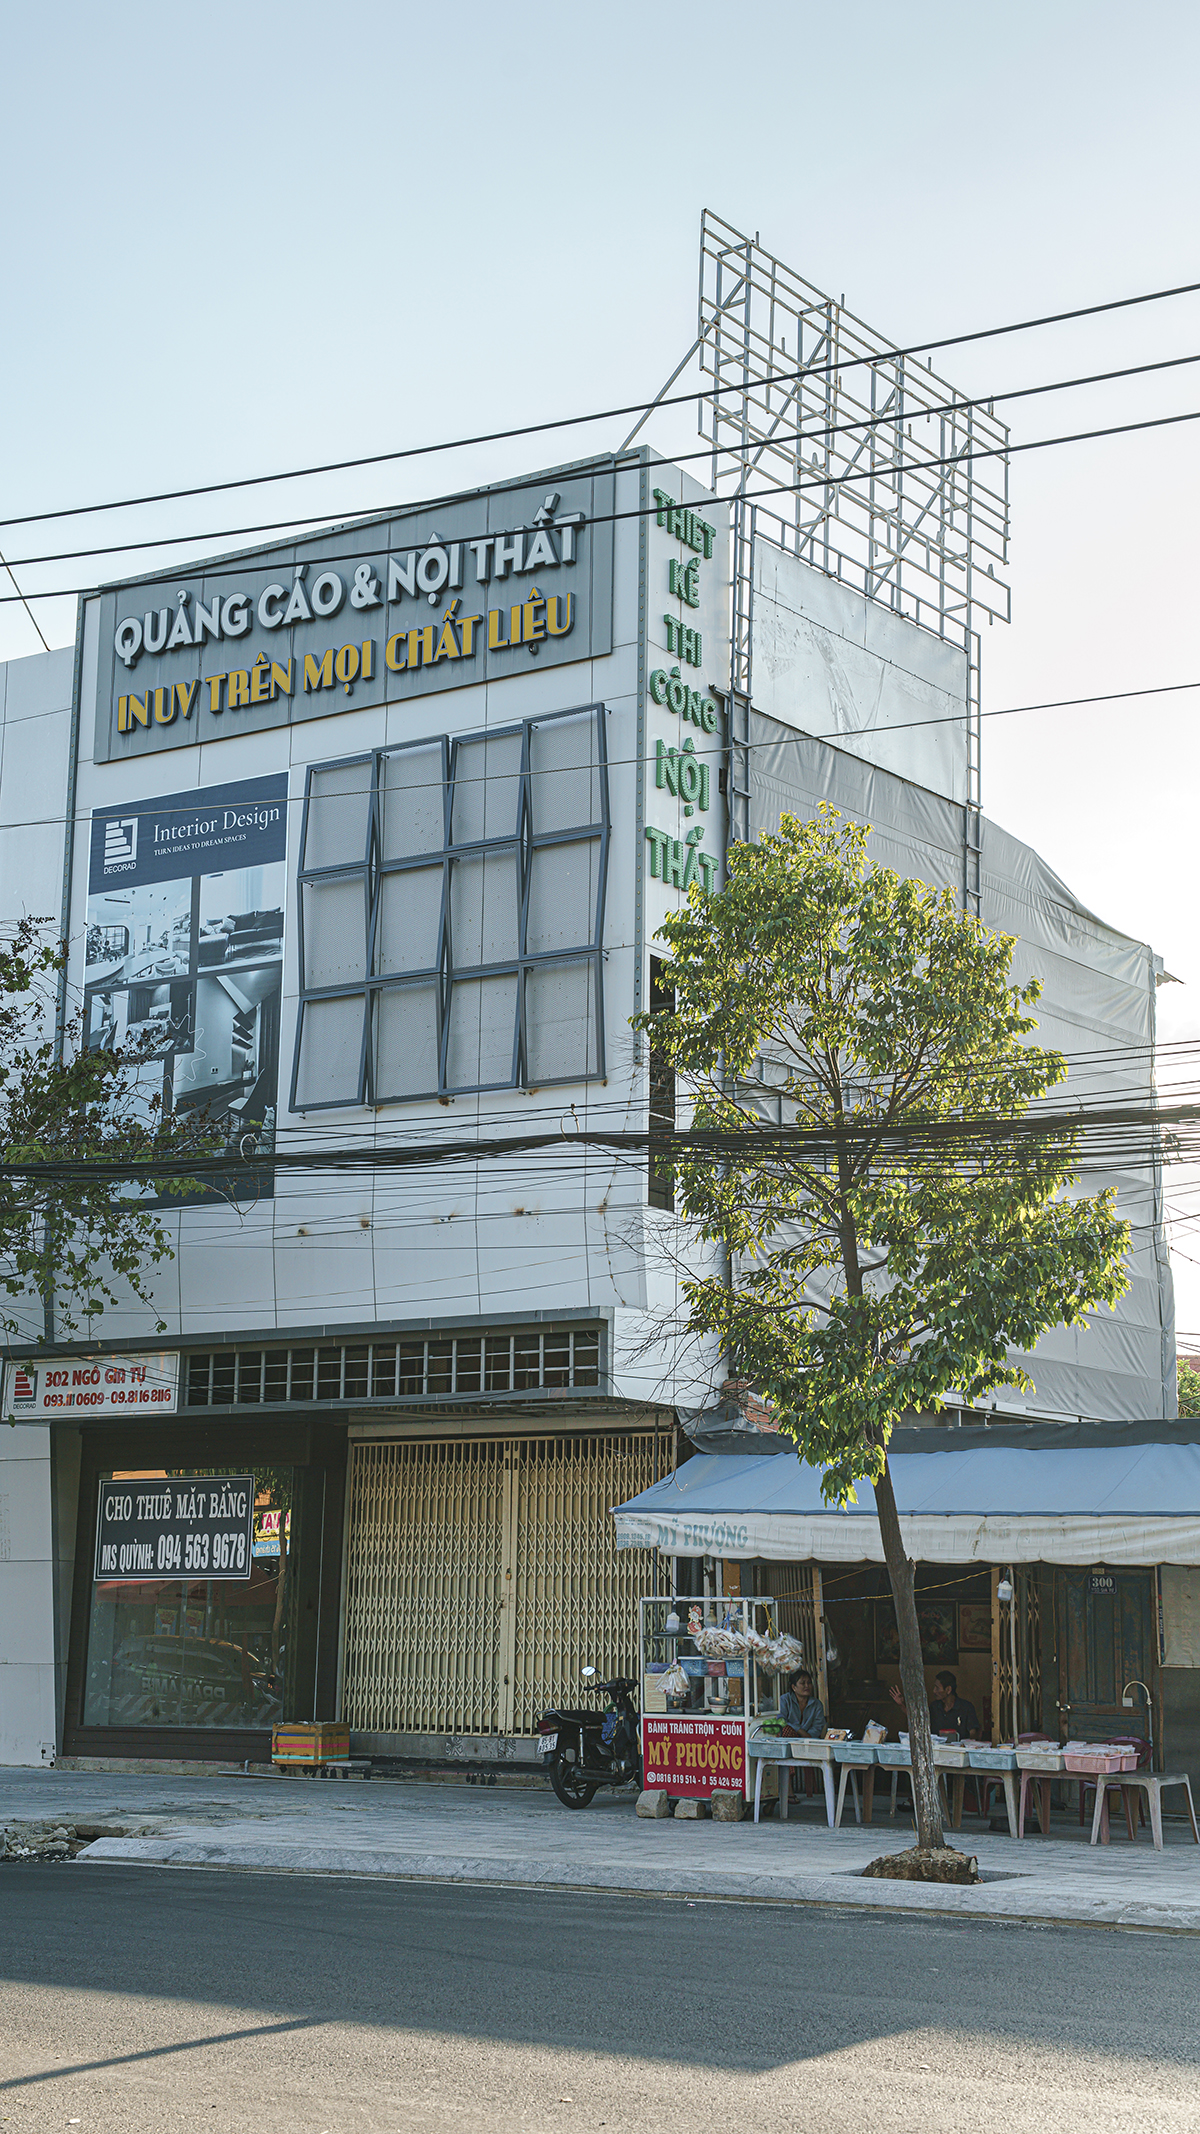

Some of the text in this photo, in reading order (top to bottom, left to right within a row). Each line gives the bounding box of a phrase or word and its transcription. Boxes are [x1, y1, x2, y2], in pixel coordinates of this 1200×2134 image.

[114, 492, 586, 668] QUẢNG CÁO & NỘI THẤT
[669, 557, 701, 608] KẾ
[117, 586, 576, 733] IN UV TRÊN MỌI CHẤT LIỆU
[663, 613, 702, 668] THI
[650, 666, 718, 734] CÔNG
[656, 737, 710, 817] NỘI
[153, 806, 280, 843] Interior Design
[154, 847, 171, 856] TURN
[172, 844, 191, 852] IDEAS
[200, 838, 223, 848] DREAM
[223, 833, 247, 844] SPACES
[646, 825, 719, 895] THẤT
[103, 862, 137, 875] DECORAD
[45, 1371, 69, 1387] 302
[72, 1365, 100, 1386] NGÔ
[13, 1402, 37, 1410] DECORAD
[105, 1481, 247, 1526] CHO THUÊ MẶT BẰNG
[101, 1532, 246, 1573] MS QUỲNH: 094 563 9678
[656, 1518, 680, 1547] MỸ
[683, 1520, 749, 1554] PHƯỢNG
[1092, 1577, 1113, 1588] 300
[647, 1721, 668, 1734] BÁNH
[669, 1721, 693, 1734] TRÁNG
[694, 1722, 714, 1737] TRỘN
[721, 1721, 742, 1736] CUỐN
[648, 1735, 743, 1774] MỸ PHƯỢNG
[656, 1773, 671, 1783] 0816
[672, 1774, 684, 1784] 819
[685, 1774, 696, 1784] 514
[718, 1776, 730, 1787] 424
[731, 1777, 743, 1788] 592
